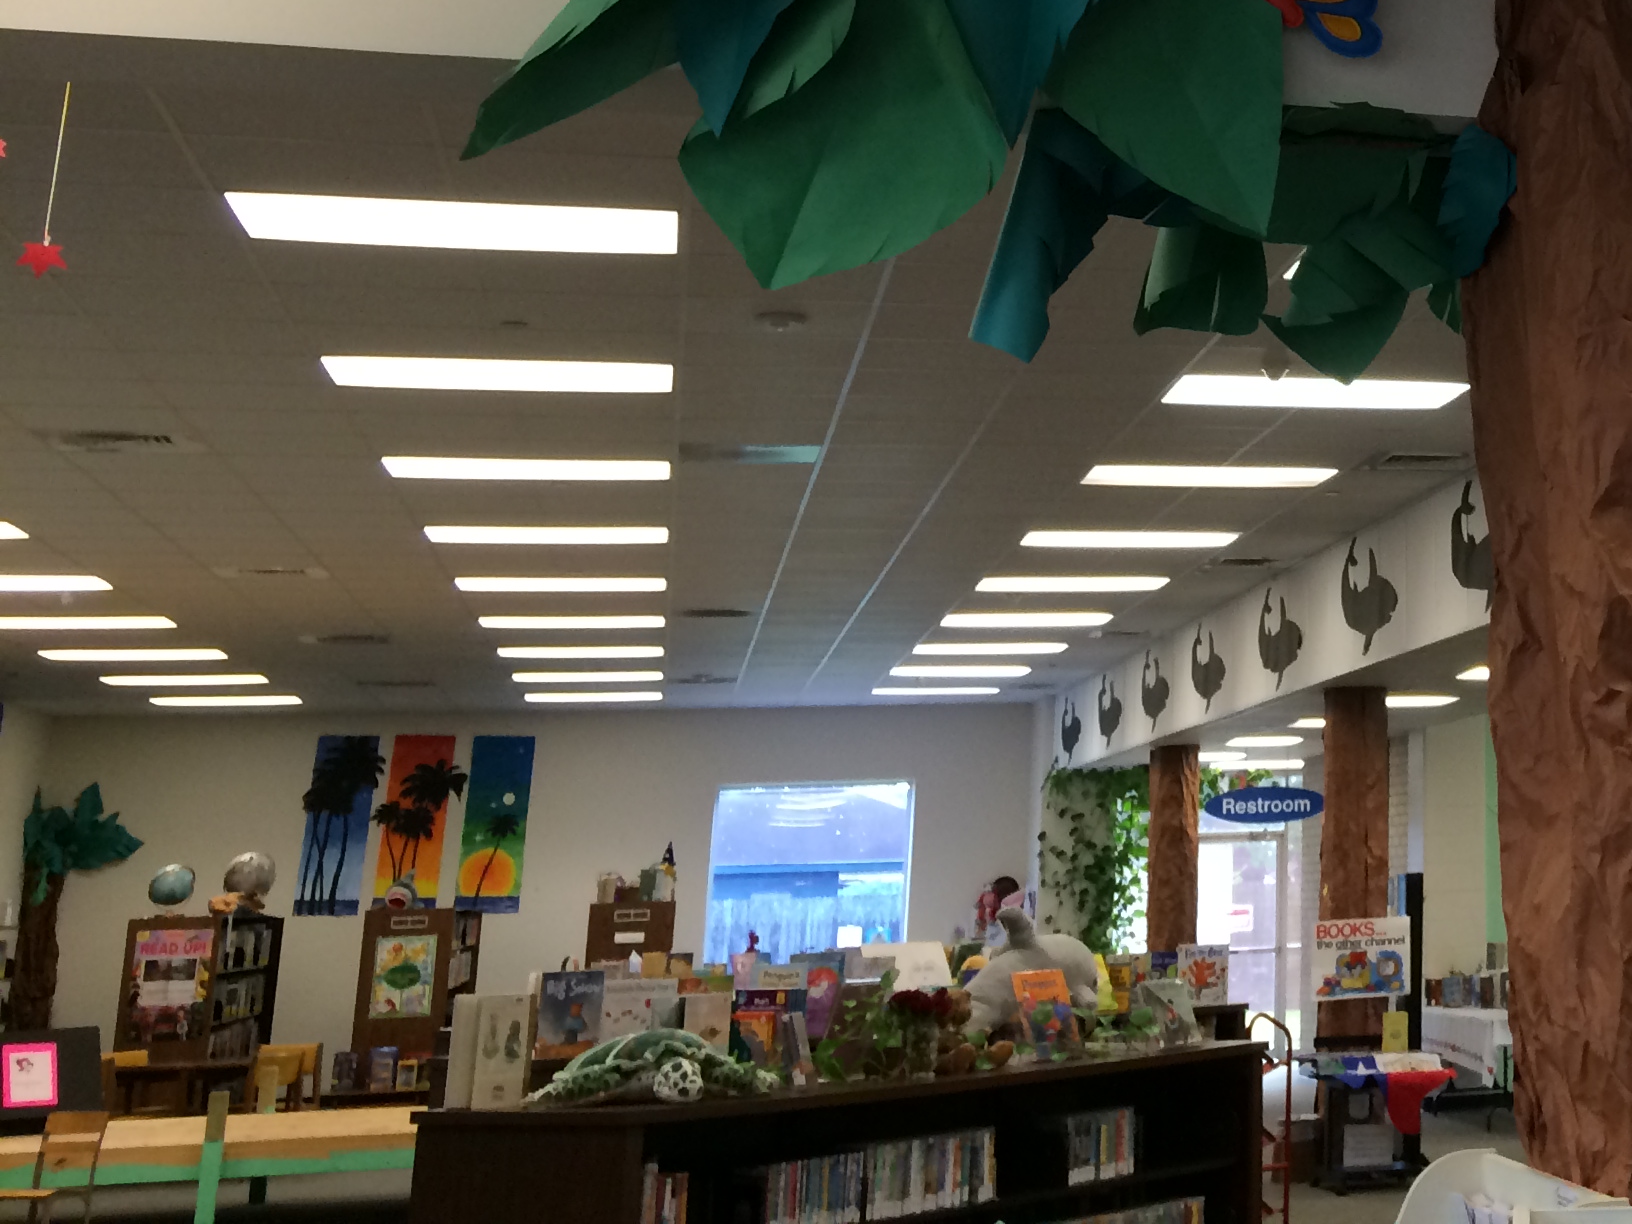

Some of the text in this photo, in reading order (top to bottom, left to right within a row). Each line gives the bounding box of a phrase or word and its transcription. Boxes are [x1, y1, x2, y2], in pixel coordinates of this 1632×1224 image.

[1222, 797, 1311, 815] Restroom
[140, 941, 207, 955] READ UP!
[1316, 935, 1406, 951] the other channel
